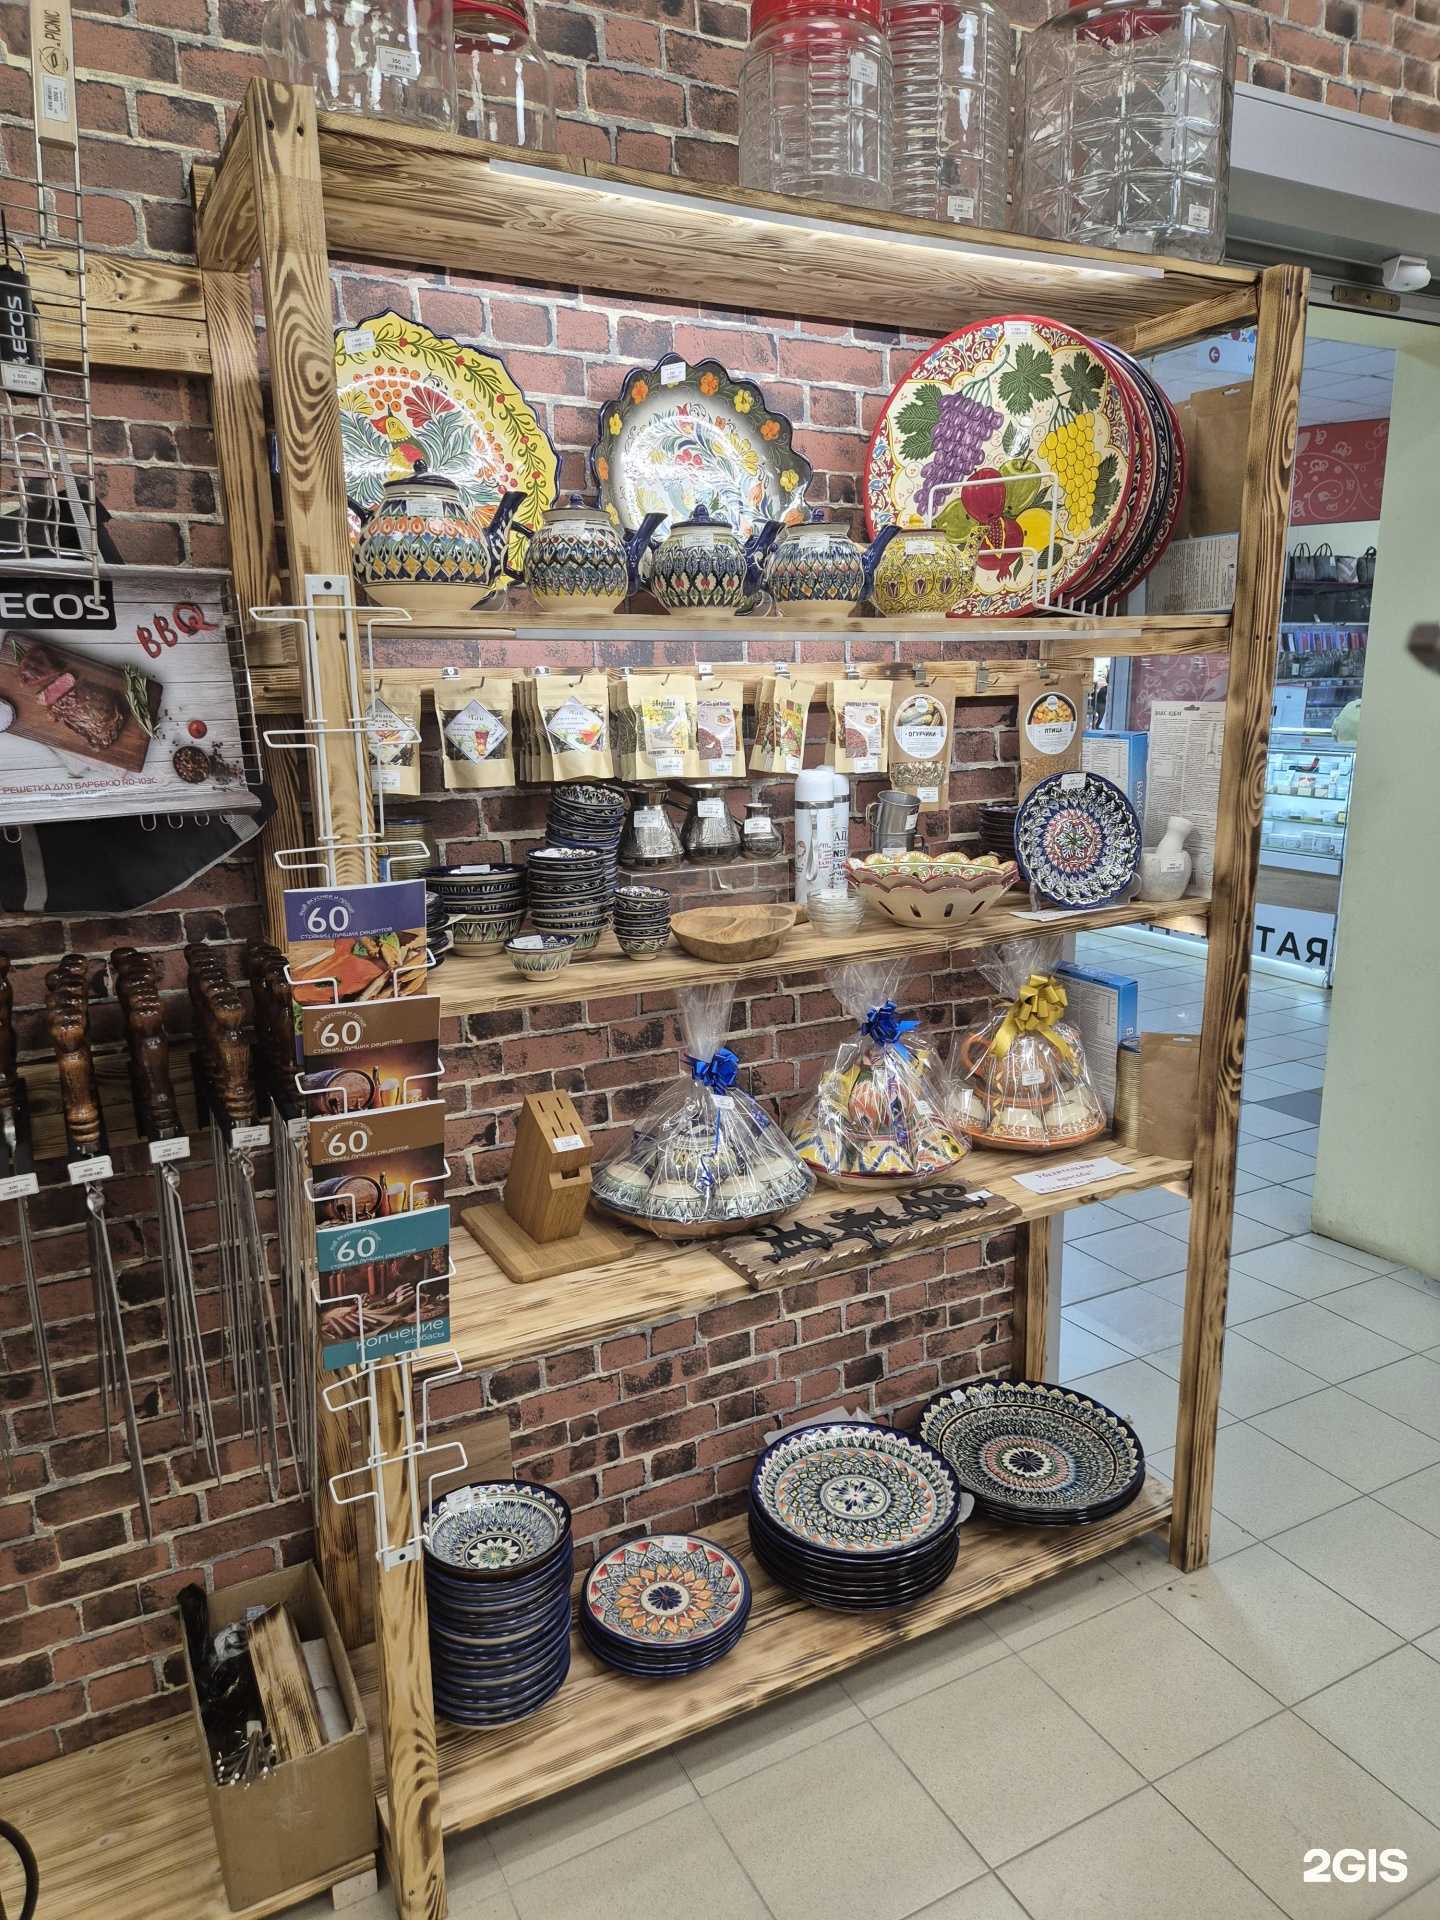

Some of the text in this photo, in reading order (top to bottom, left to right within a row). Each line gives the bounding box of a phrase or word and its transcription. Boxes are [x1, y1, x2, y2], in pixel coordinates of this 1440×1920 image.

[7, 295, 28, 354] ECOS
[0, 592, 110, 620] ECOS
[136, 602, 219, 659] BBQ
[52, 783, 73, 791] ДЛЯ
[307, 906, 350, 933] 60
[1255, 924, 1329, 967] ТАЯ
[320, 1021, 362, 1048] 60
[328, 1130, 368, 1157] 60
[337, 1236, 376, 1262] 60
[356, 1319, 444, 1350] копчение
[404, 1332, 445, 1344] кобасы
